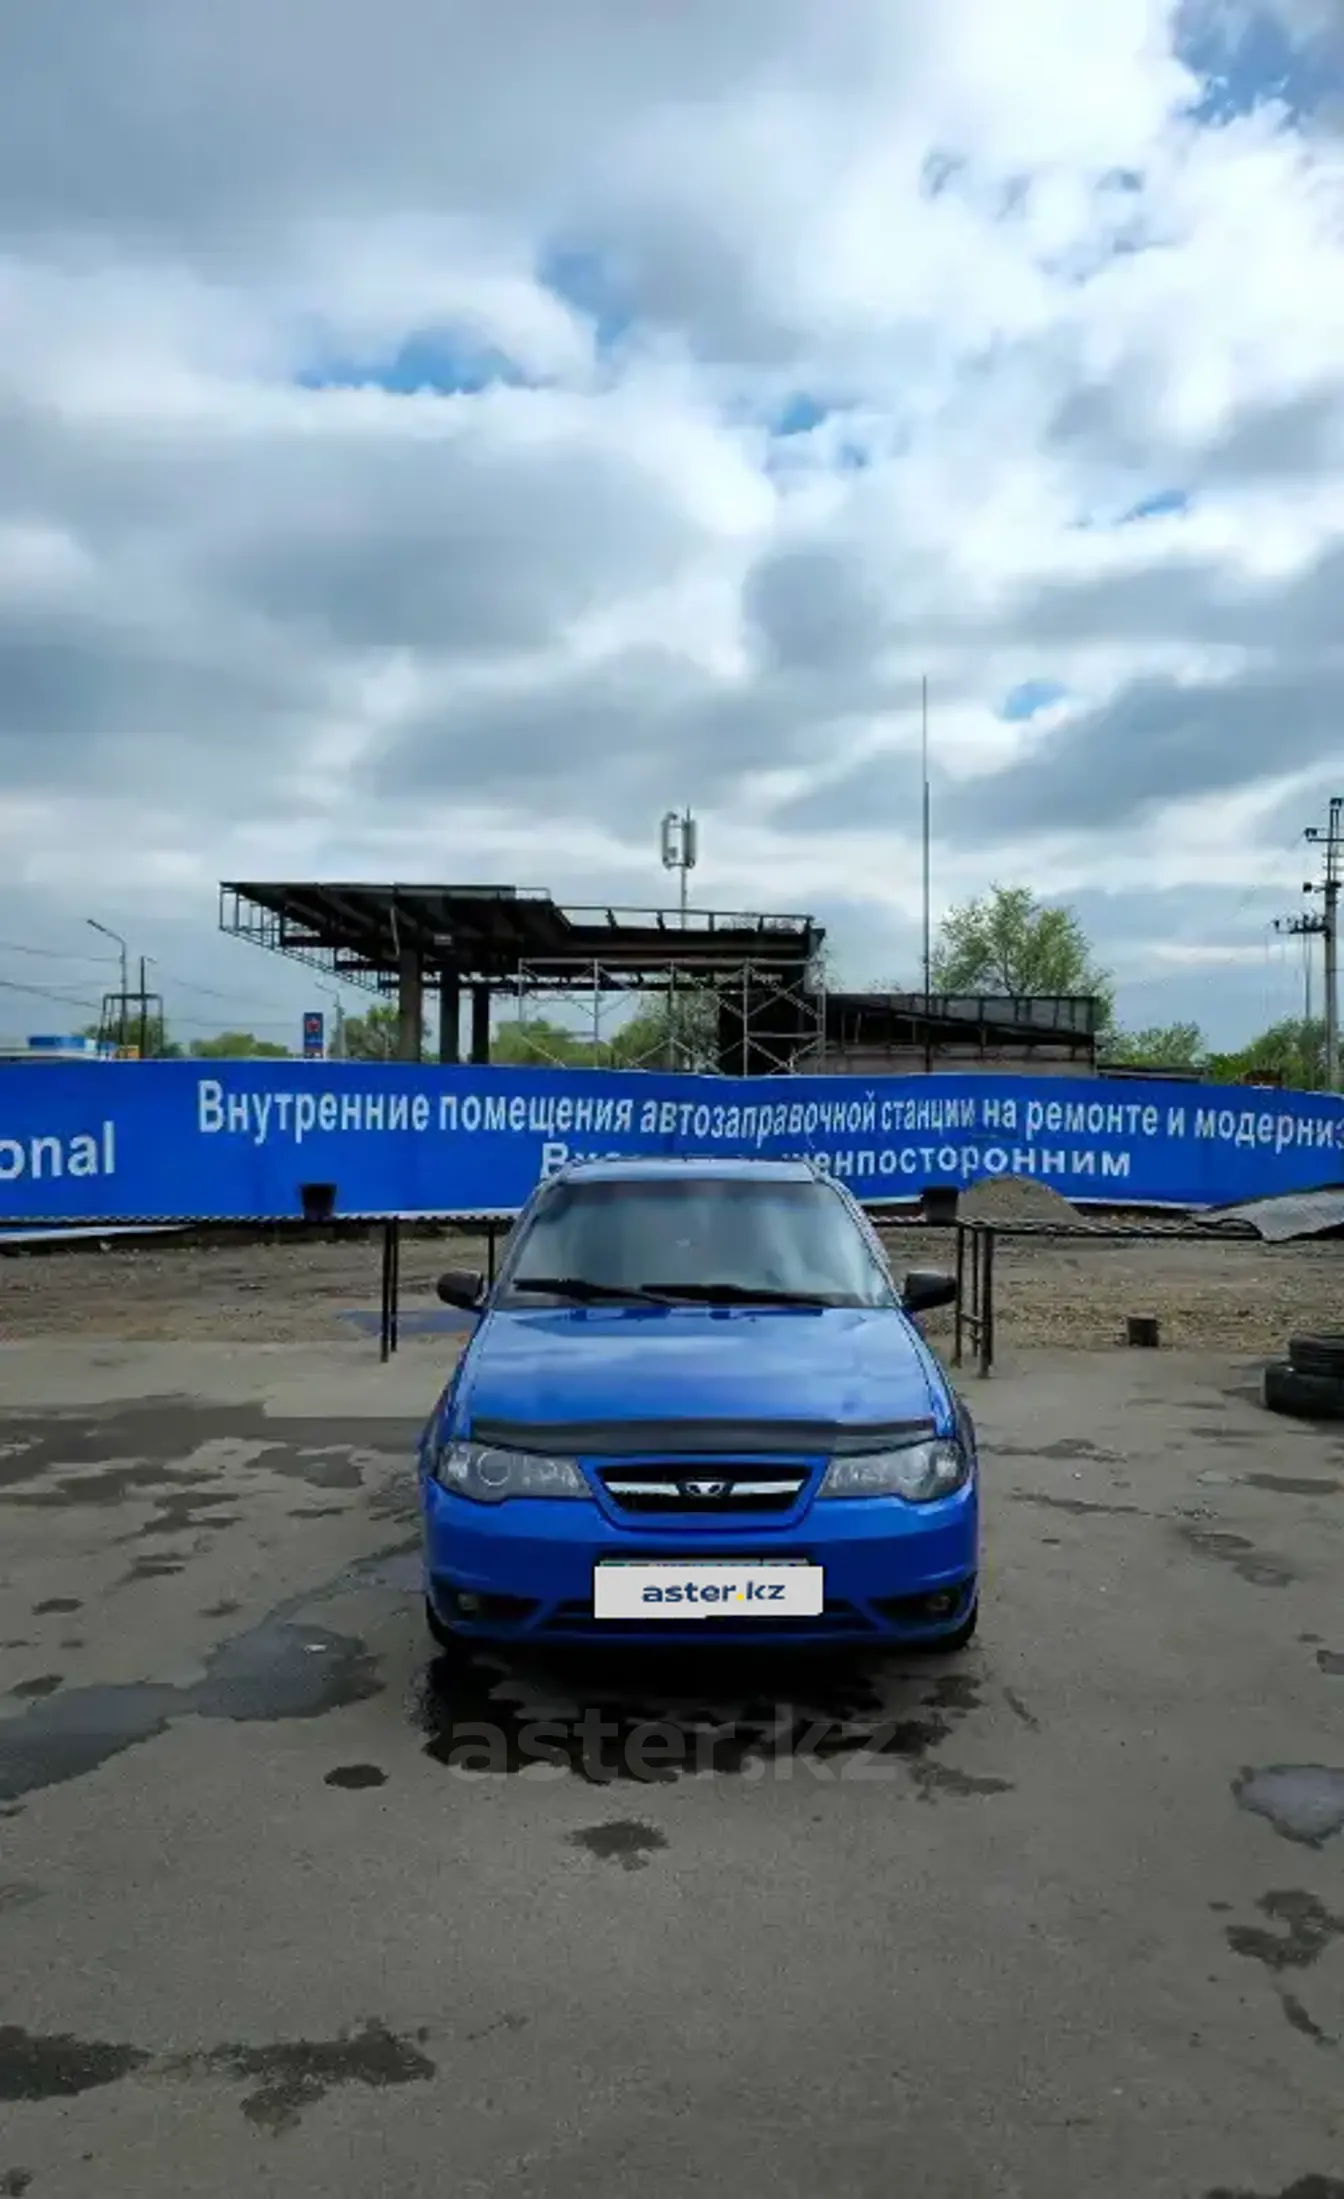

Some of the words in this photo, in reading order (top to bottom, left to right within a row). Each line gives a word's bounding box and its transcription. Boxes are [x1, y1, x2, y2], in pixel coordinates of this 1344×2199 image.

[198, 1080, 430, 1145] Внутренние
[439, 1093, 634, 1138] помещения
[640, 1090, 876, 1149] автозаправочной
[881, 1098, 976, 1135] станции
[982, 1099, 1017, 1129] на
[1026, 1100, 1158, 1141] ремонте
[1167, 1107, 1185, 1138] и
